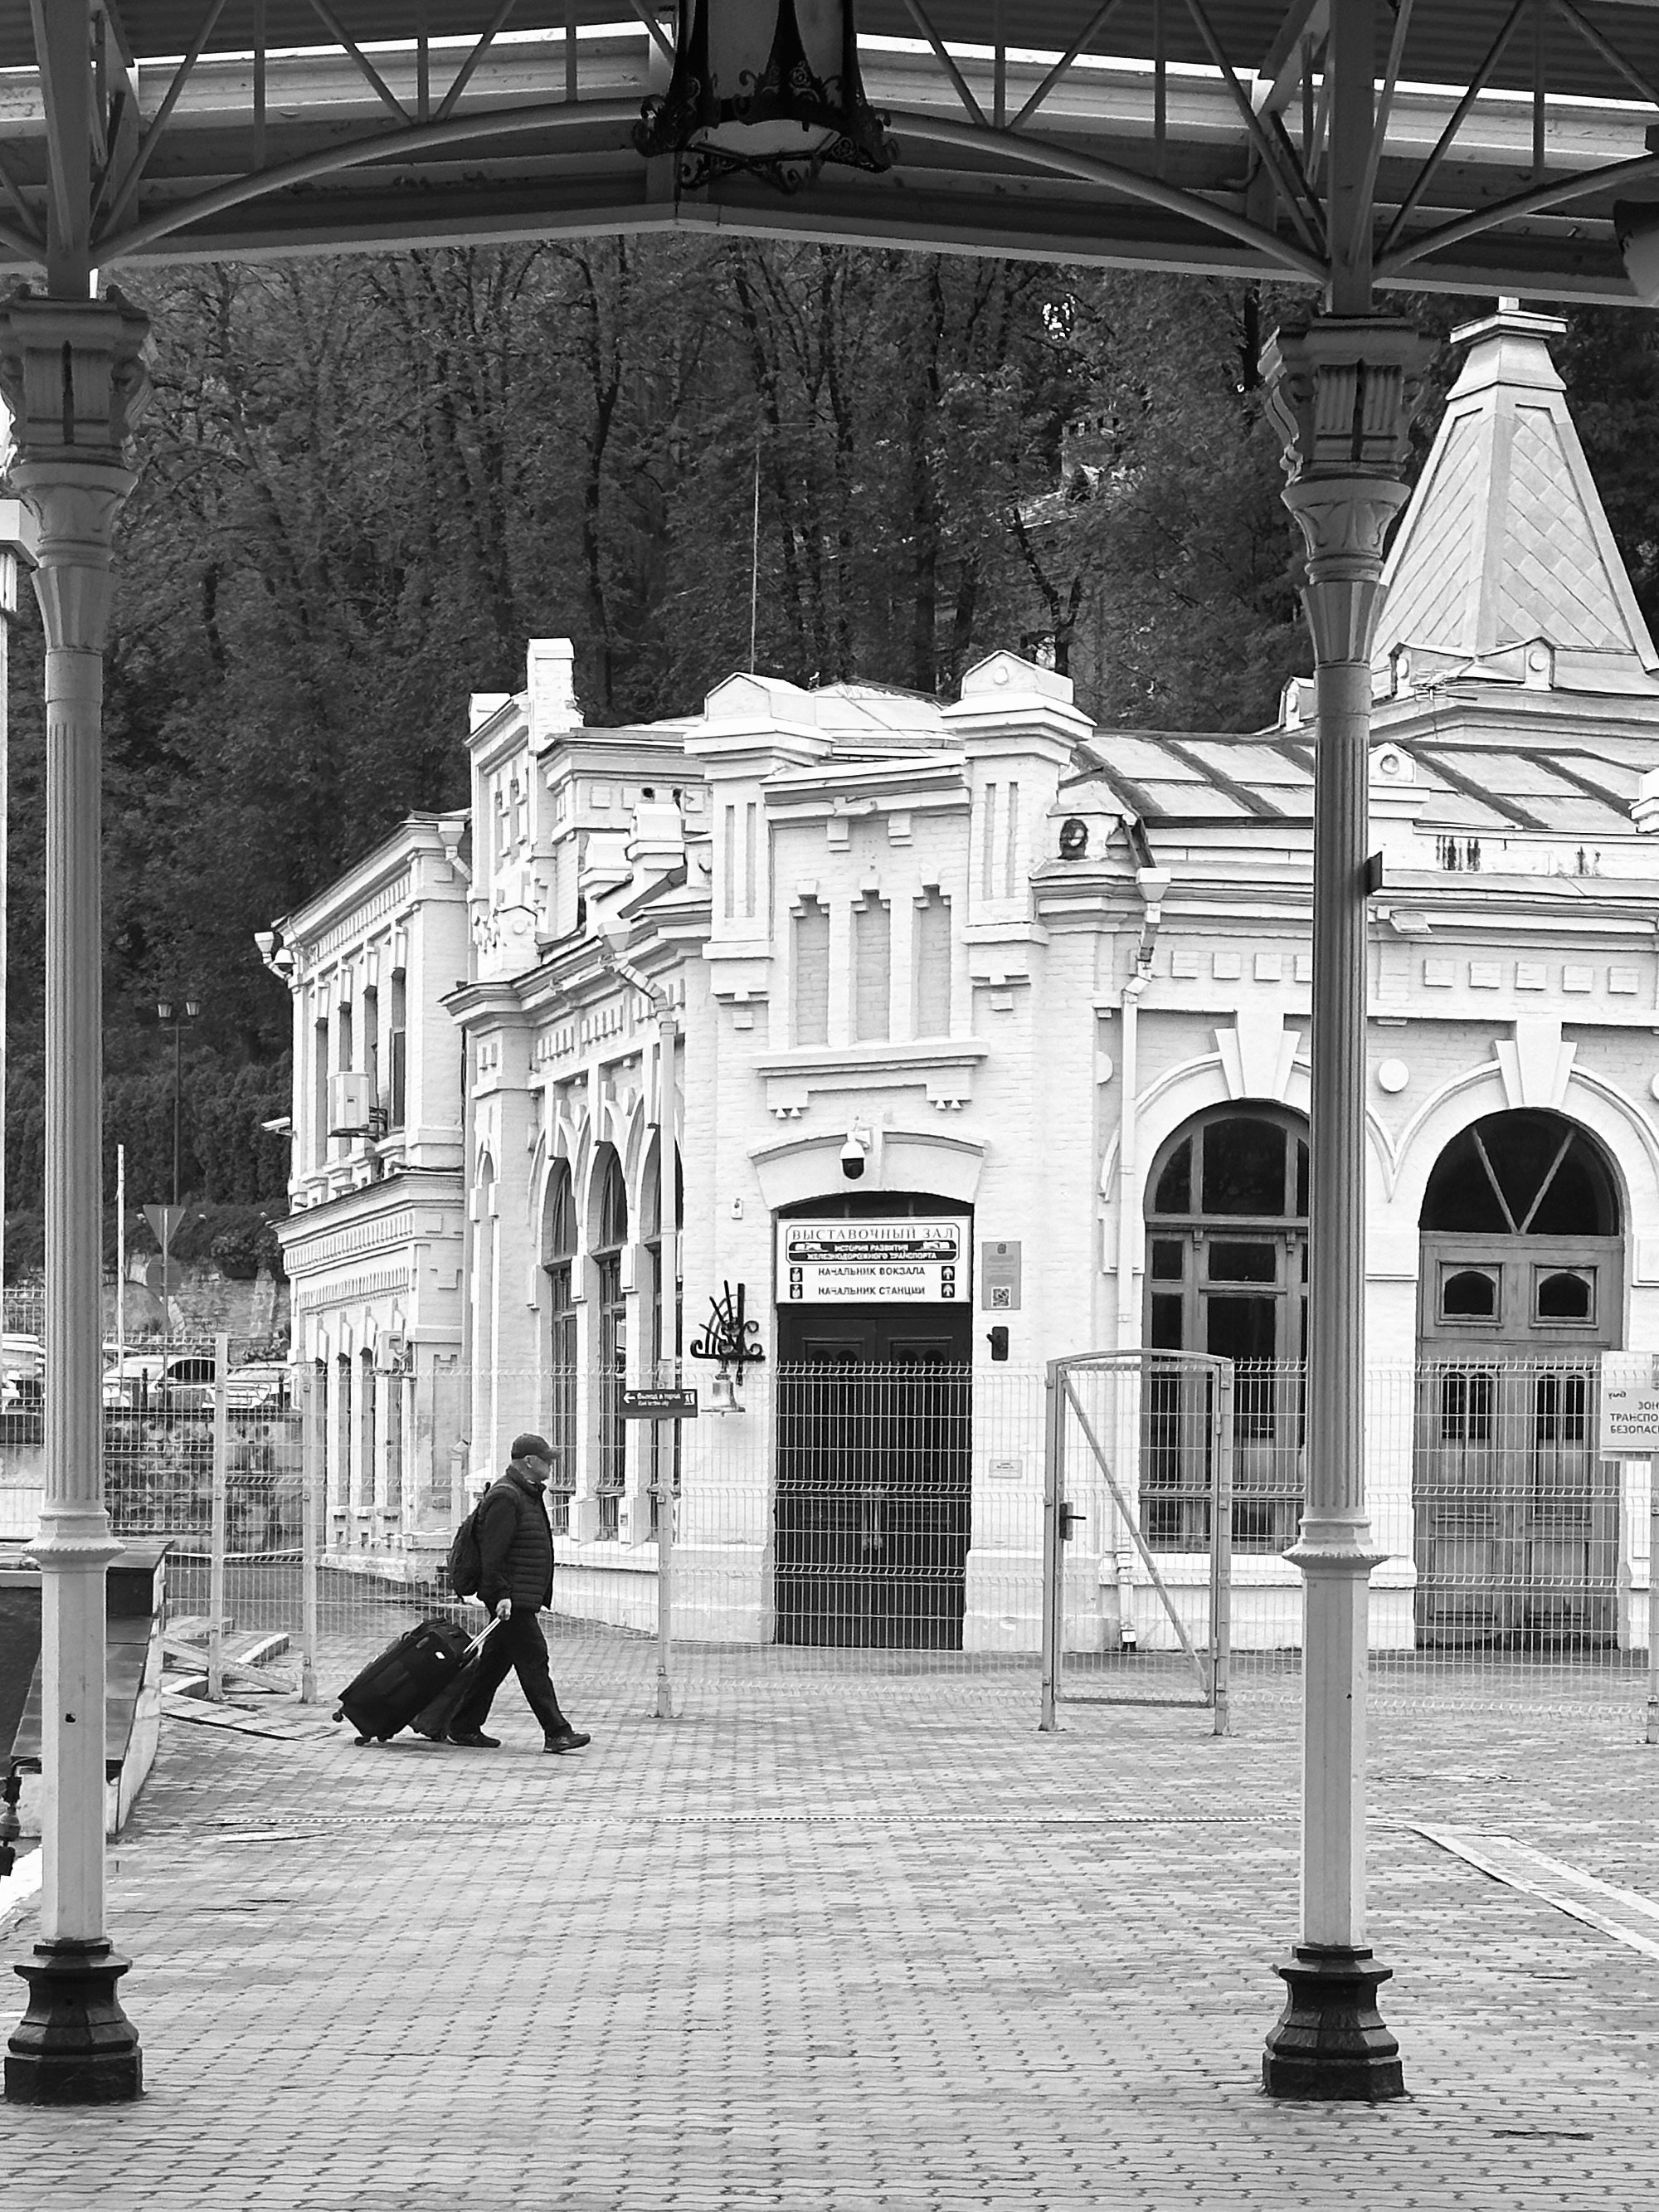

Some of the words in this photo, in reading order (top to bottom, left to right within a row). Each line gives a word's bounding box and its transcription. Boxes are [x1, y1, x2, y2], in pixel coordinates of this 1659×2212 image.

[792, 1226, 916, 1240] ВЫСТАВОЧНЫЙ
[922, 1228, 953, 1239] ЗАЛ
[818, 1268, 877, 1276] НАЧАЛЬНИК
[879, 1267, 926, 1275] ВОКЗАЛА
[818, 1287, 877, 1295] НАЧАЛЬНИК
[878, 1286, 925, 1296] СТАНЦИИ
[1609, 1413, 1659, 1422] ТРАНСПО
[1610, 1425, 1659, 1434] БЕЗОПАС
